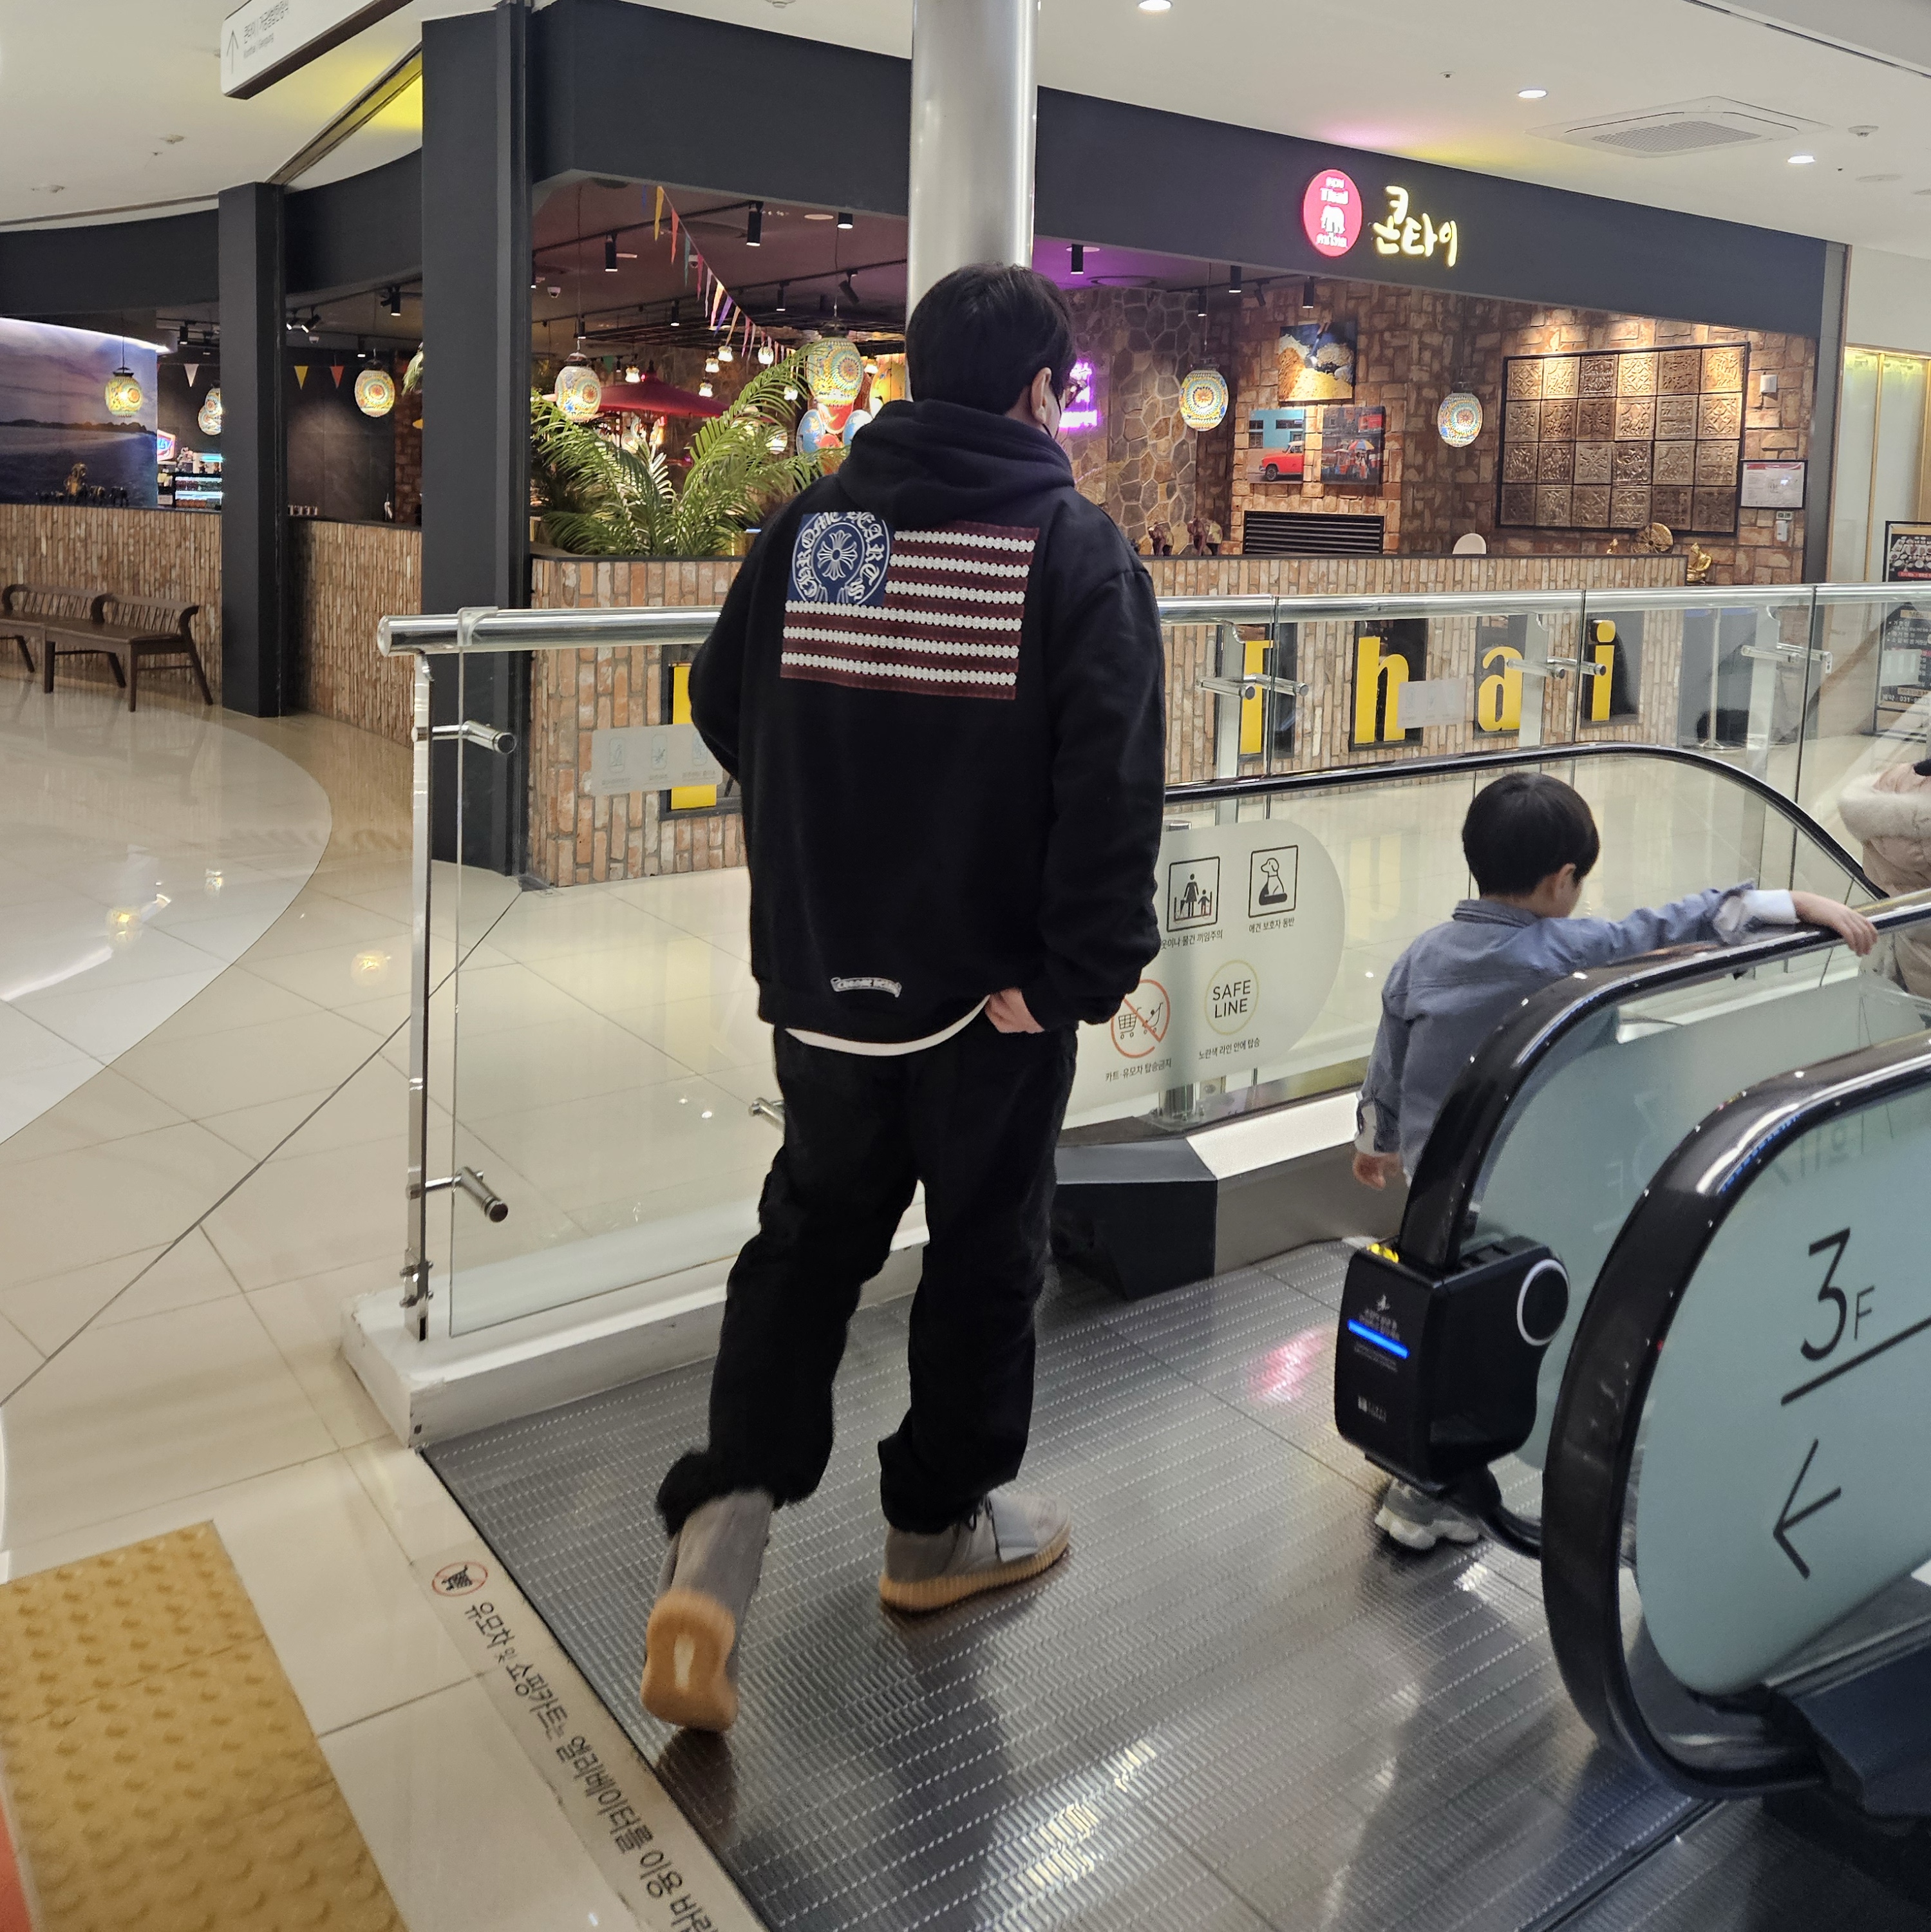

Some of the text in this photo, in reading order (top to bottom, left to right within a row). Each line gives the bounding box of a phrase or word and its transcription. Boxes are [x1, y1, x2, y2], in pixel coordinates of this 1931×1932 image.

[1373, 185, 1458, 267] 콘타이
[1263, 919, 1281, 930] 보호자
[1283, 916, 1295, 928] 동반
[1212, 980, 1251, 1001] SAFE
[1214, 998, 1248, 1019] LINE
[1198, 1037, 1261, 1060] 노란색 라인 안에 탑승
[1144, 1057, 1172, 1074] 탑승금지
[1800, 1226, 1875, 1361] 3F
[464, 1602, 516, 1649] 유모차
[505, 1663, 568, 1741] 쇼핑카트는
[555, 1736, 654, 1854] 엘리베이터를
[640, 1850, 683, 1899] 이용
